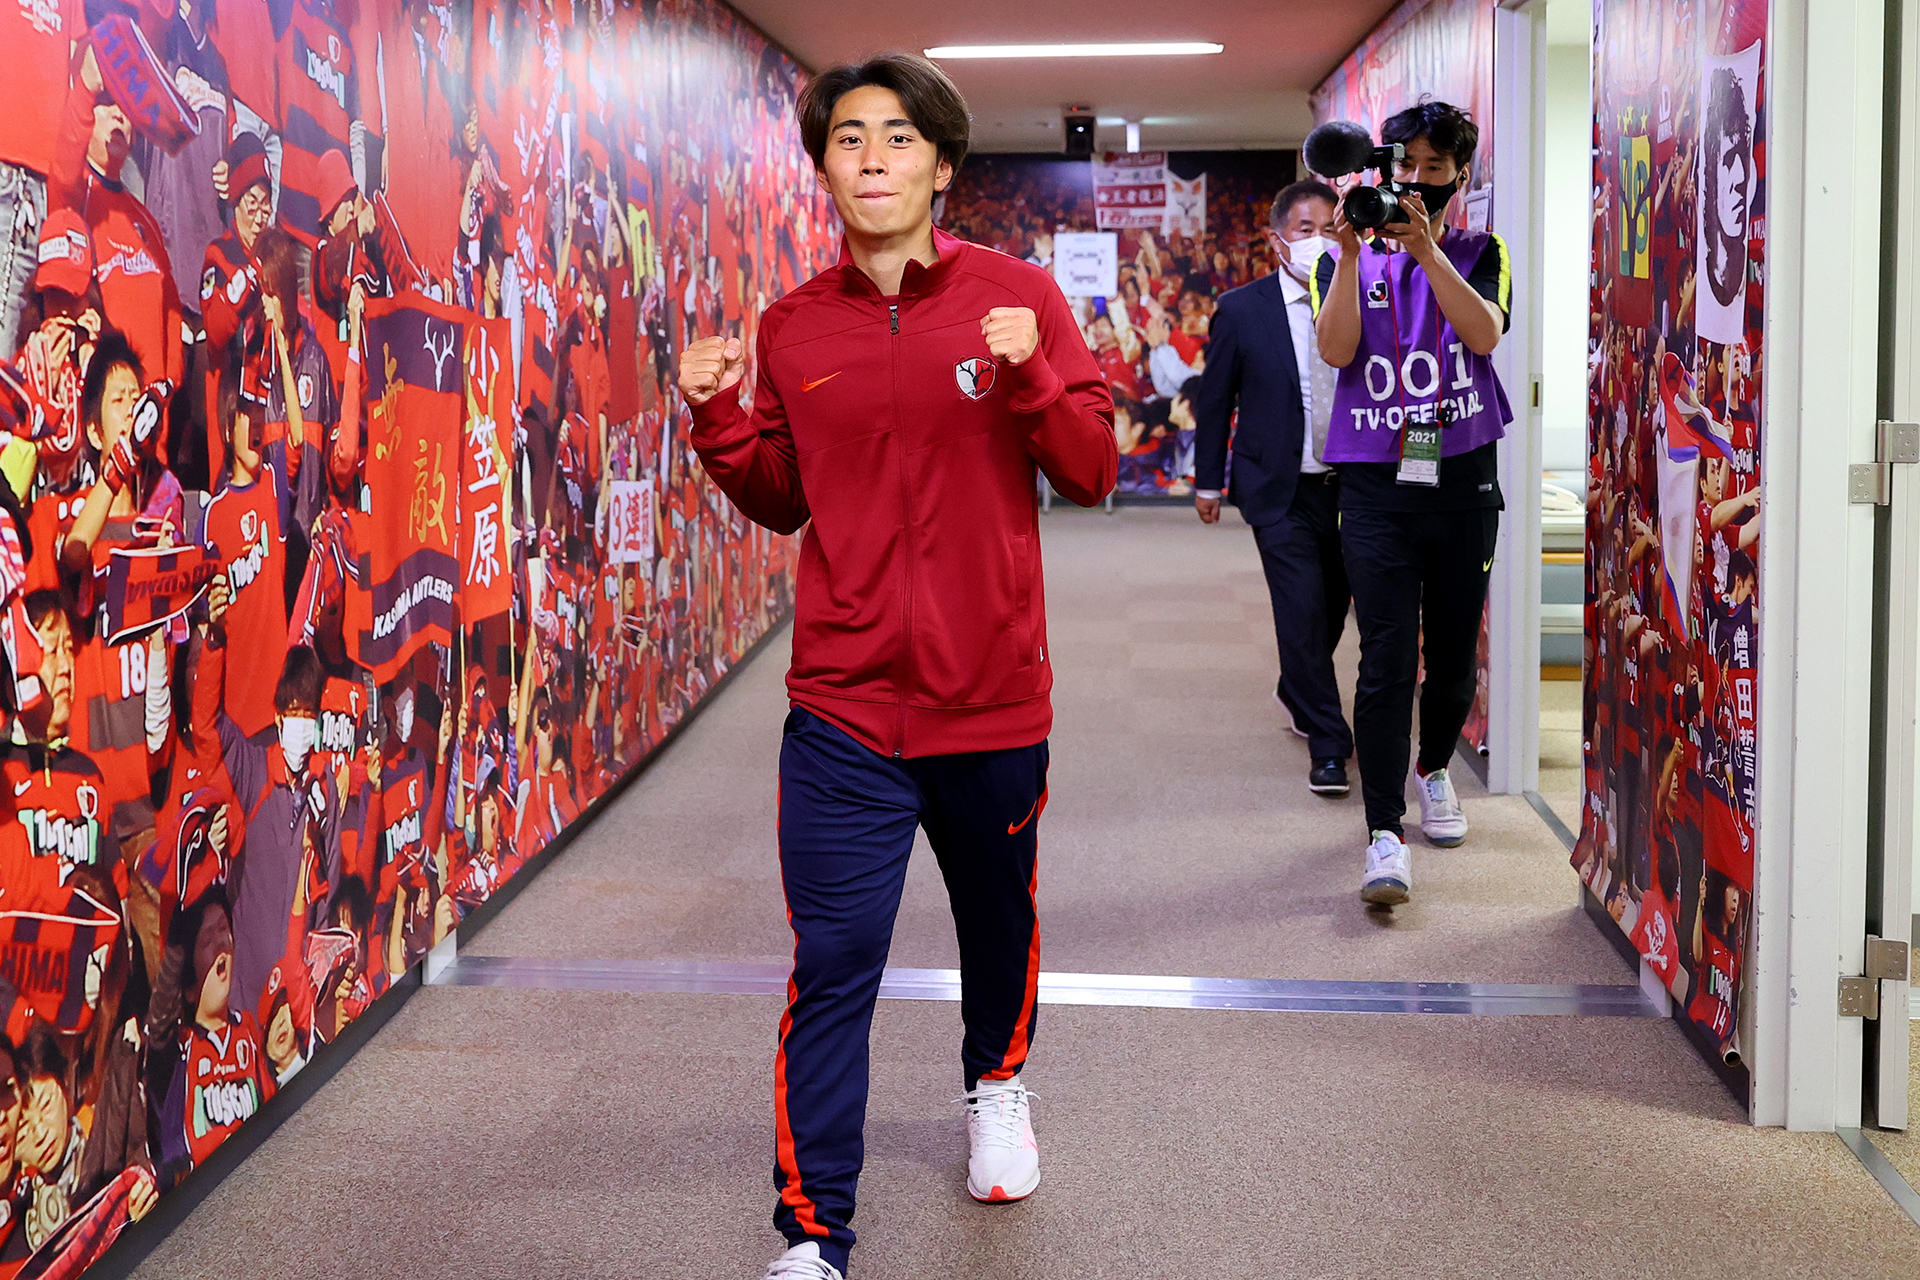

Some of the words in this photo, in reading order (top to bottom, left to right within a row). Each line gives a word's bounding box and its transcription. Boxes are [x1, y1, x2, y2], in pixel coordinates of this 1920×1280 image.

[1364, 342, 1474, 402] 001
[466, 326, 501, 588] 小笠原
[1407, 430, 1437, 444] 2021
[412, 575, 453, 607] ANTLERS
[119, 642, 146, 698] 18
